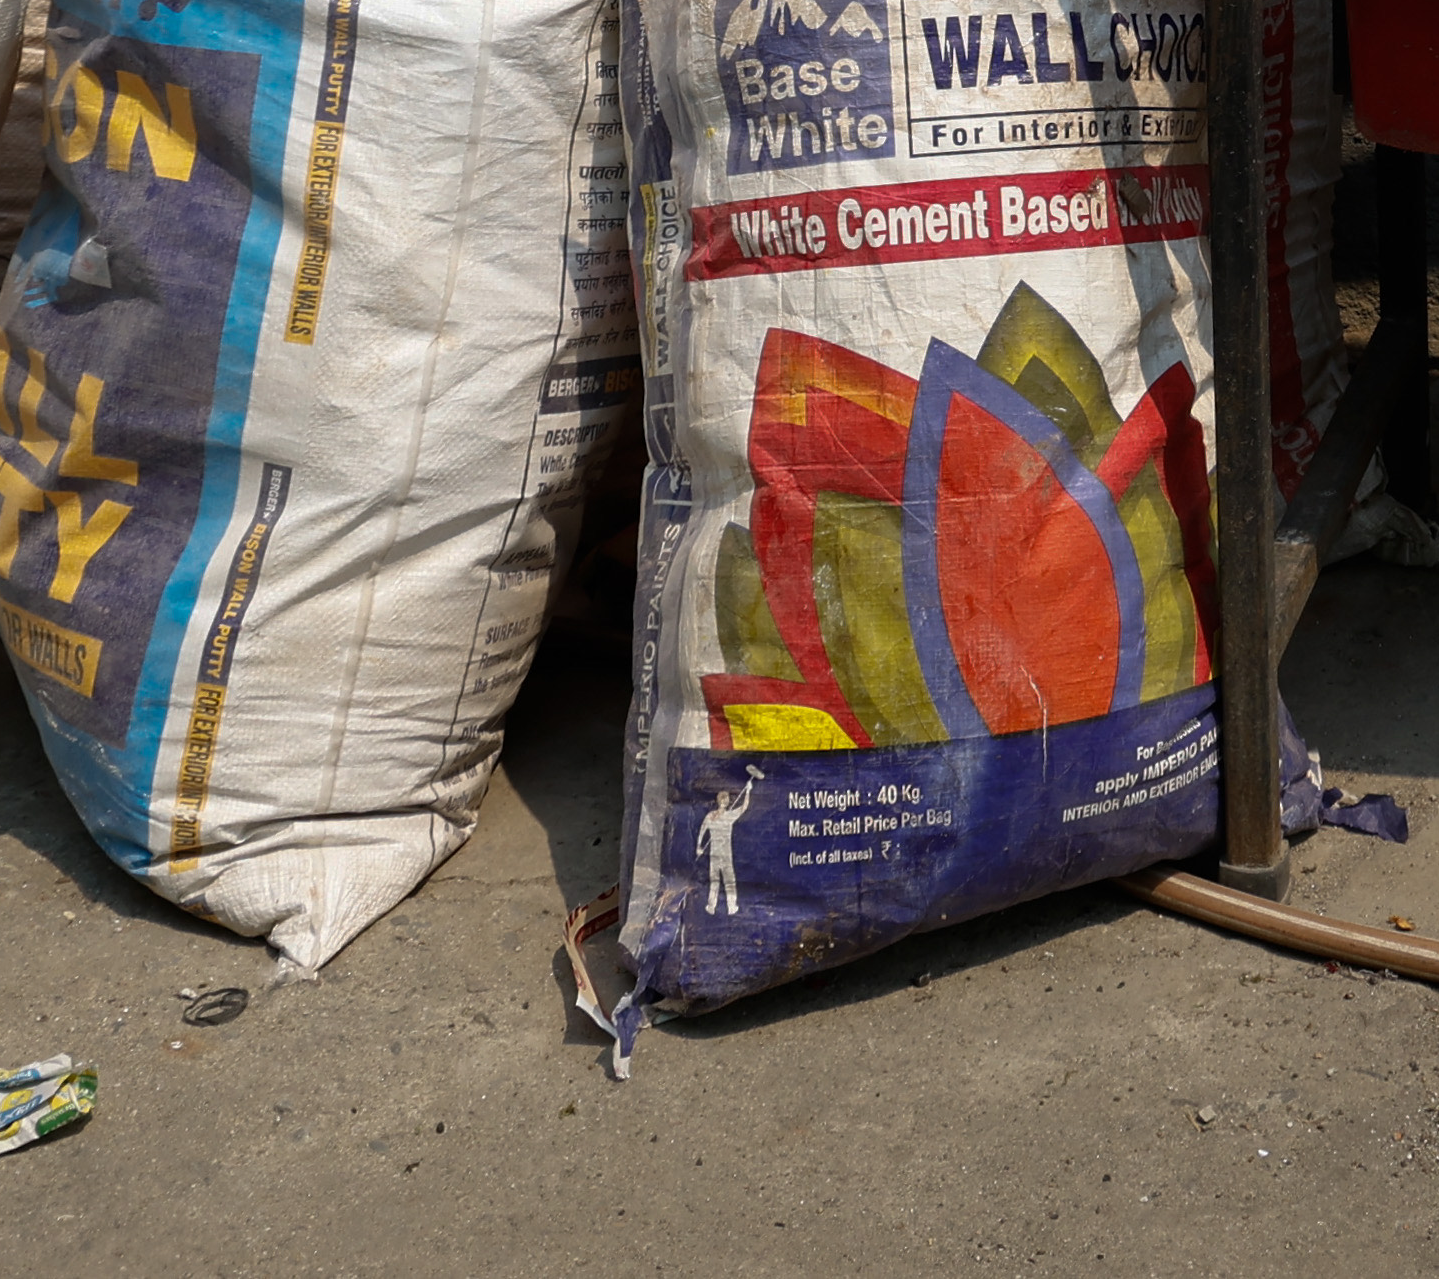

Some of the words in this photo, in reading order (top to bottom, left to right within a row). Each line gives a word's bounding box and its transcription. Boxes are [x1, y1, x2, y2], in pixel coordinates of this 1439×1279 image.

[331, 17, 350, 60] WALL
[921, 11, 1104, 91] WALL
[322, 62, 344, 116] PUTTY
[735, 56, 861, 105] Base
[316, 125, 338, 152] FOR
[746, 104, 889, 162] White
[931, 123, 984, 148] For
[998, 115, 1112, 144] Interior
[1121, 114, 1132, 136] &
[301, 154, 336, 288] EXTERIOR/INTERIOR
[730, 204, 826, 259] White
[836, 190, 990, 250] Cement
[999, 178, 1108, 237] Based
[289, 289, 318, 337] WALLS
[548, 376, 595, 398] BERGER
[264, 468, 283, 512] BERGER
[236, 522, 268, 574] BISON
[221, 577, 250, 620] WALL
[646, 522, 682, 631] PAINTS
[25, 614, 87, 688] WALLS
[206, 623, 234, 679] PUTTY
[195, 687, 223, 715] FOR
[1094, 771, 1139, 795] apply
[1142, 742, 1198, 782] IMPERIO
[1136, 745, 1154, 761] For
[788, 791, 811, 810] Net
[813, 789, 861, 812] Weight
[876, 784, 898, 805] 40
[901, 784, 924, 805] Kg.
[1062, 797, 1121, 823] INTERIOR
[1122, 789, 1148, 808] AND
[1149, 768, 1199, 800] EXTERIOR
[788, 820, 820, 838] Max.
[822, 816, 861, 836] Retail
[864, 814, 898, 834] Price
[901, 811, 924, 827] Per
[926, 808, 952, 826] Bag
[789, 851, 814, 869] (Incl.
[815, 851, 827, 865] of
[828, 849, 840, 864] all
[842, 847, 873, 863] taxes)
